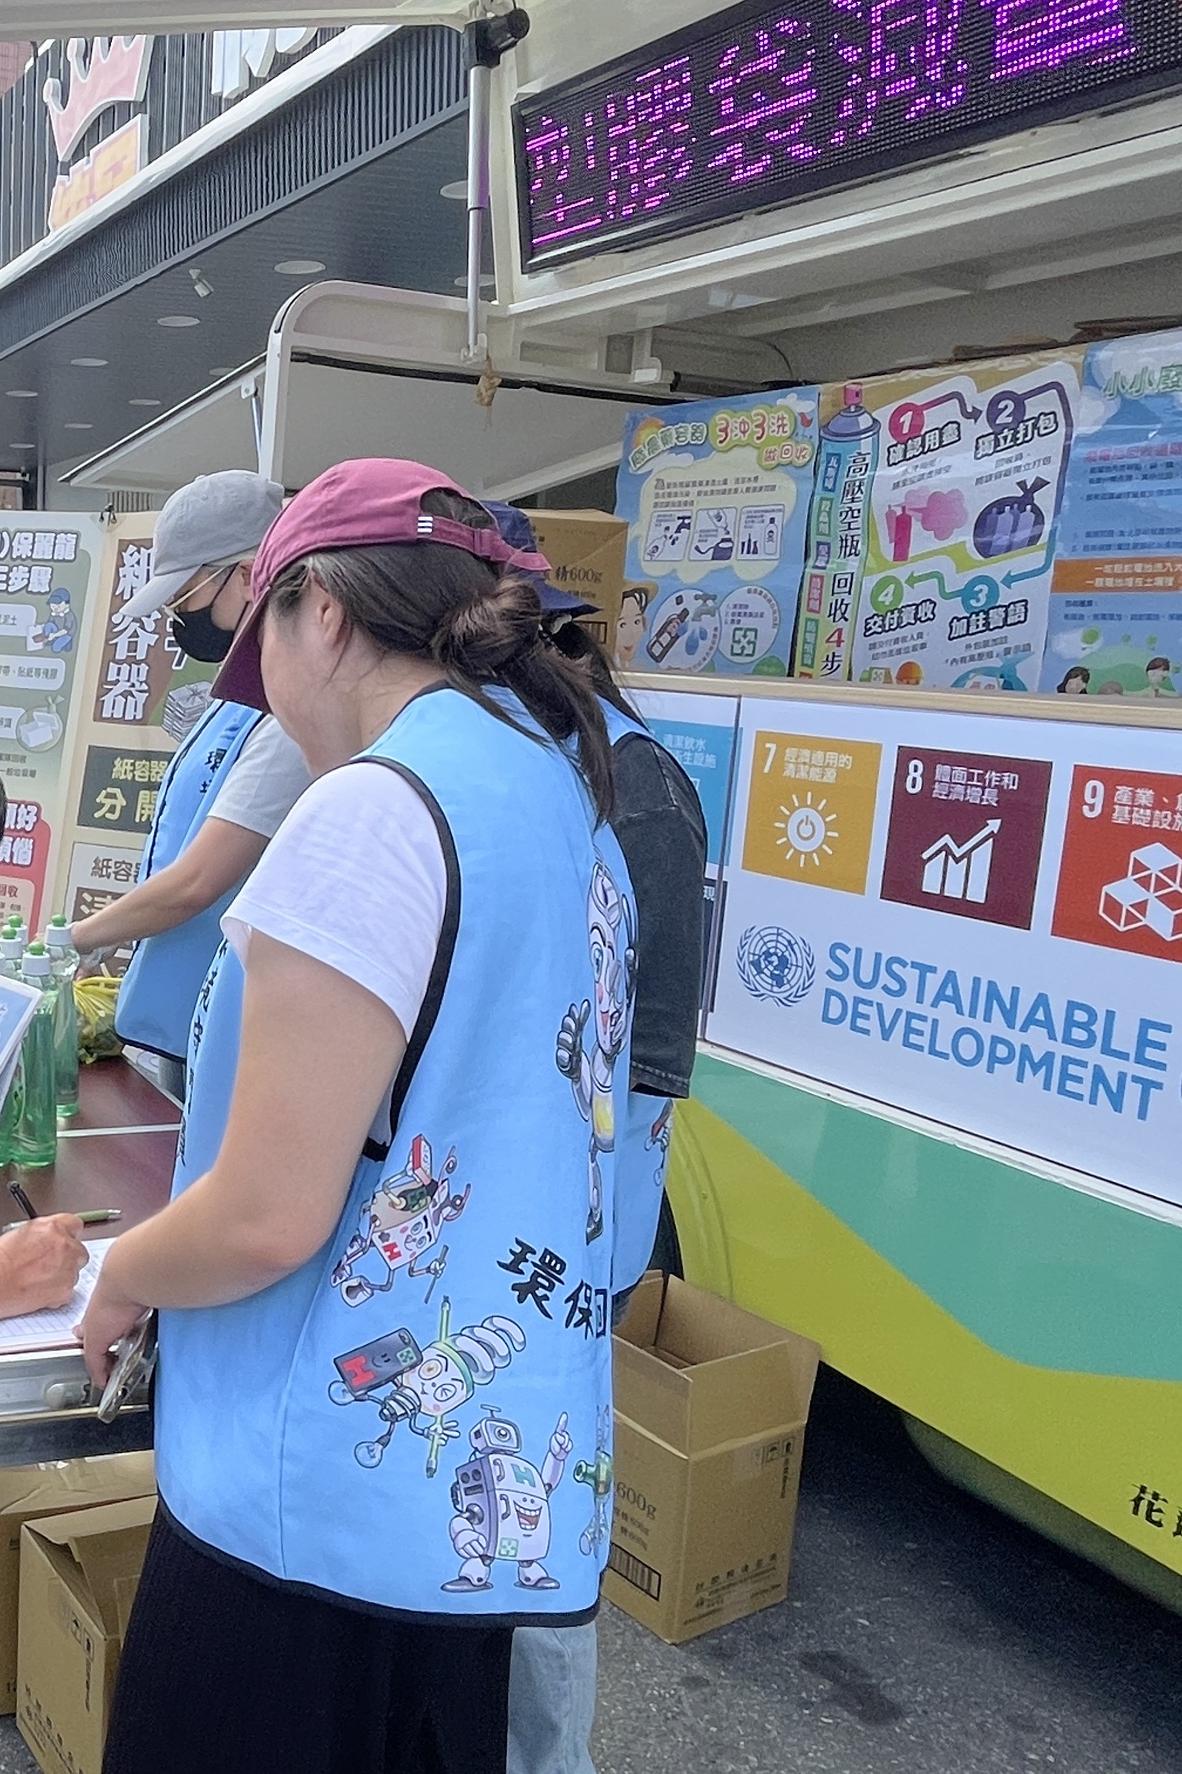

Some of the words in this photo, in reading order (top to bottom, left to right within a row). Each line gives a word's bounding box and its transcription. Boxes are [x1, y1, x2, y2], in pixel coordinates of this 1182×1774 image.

[718, 410, 790, 445] 3沖3洗
[899, 411, 914, 432] 1
[996, 401, 1015, 423] 2
[975, 413, 1058, 459] 獨立打包
[838, 451, 871, 560] 高壓空瓶
[878, 586, 896, 605] 4
[970, 585, 990, 606] 3
[820, 571, 855, 677] 回收4步
[865, 601, 937, 637] 交付資收
[949, 600, 1028, 638] 加註警語
[112, 757, 168, 782] 紙容器
[763, 743, 777, 773] 7
[783, 763, 837, 783] 清潔能源
[785, 747, 852, 769] 經濟適用的
[904, 759, 924, 794] 8
[935, 764, 1018, 791] 體面工作和
[932, 782, 999, 807] 經濟增長
[1082, 780, 1105, 818] 9
[825, 942, 1172, 1072] SUSTAINABLE
[822, 990, 1164, 1121] DEVELOPMENT
[1129, 1484, 1182, 1538] 花
